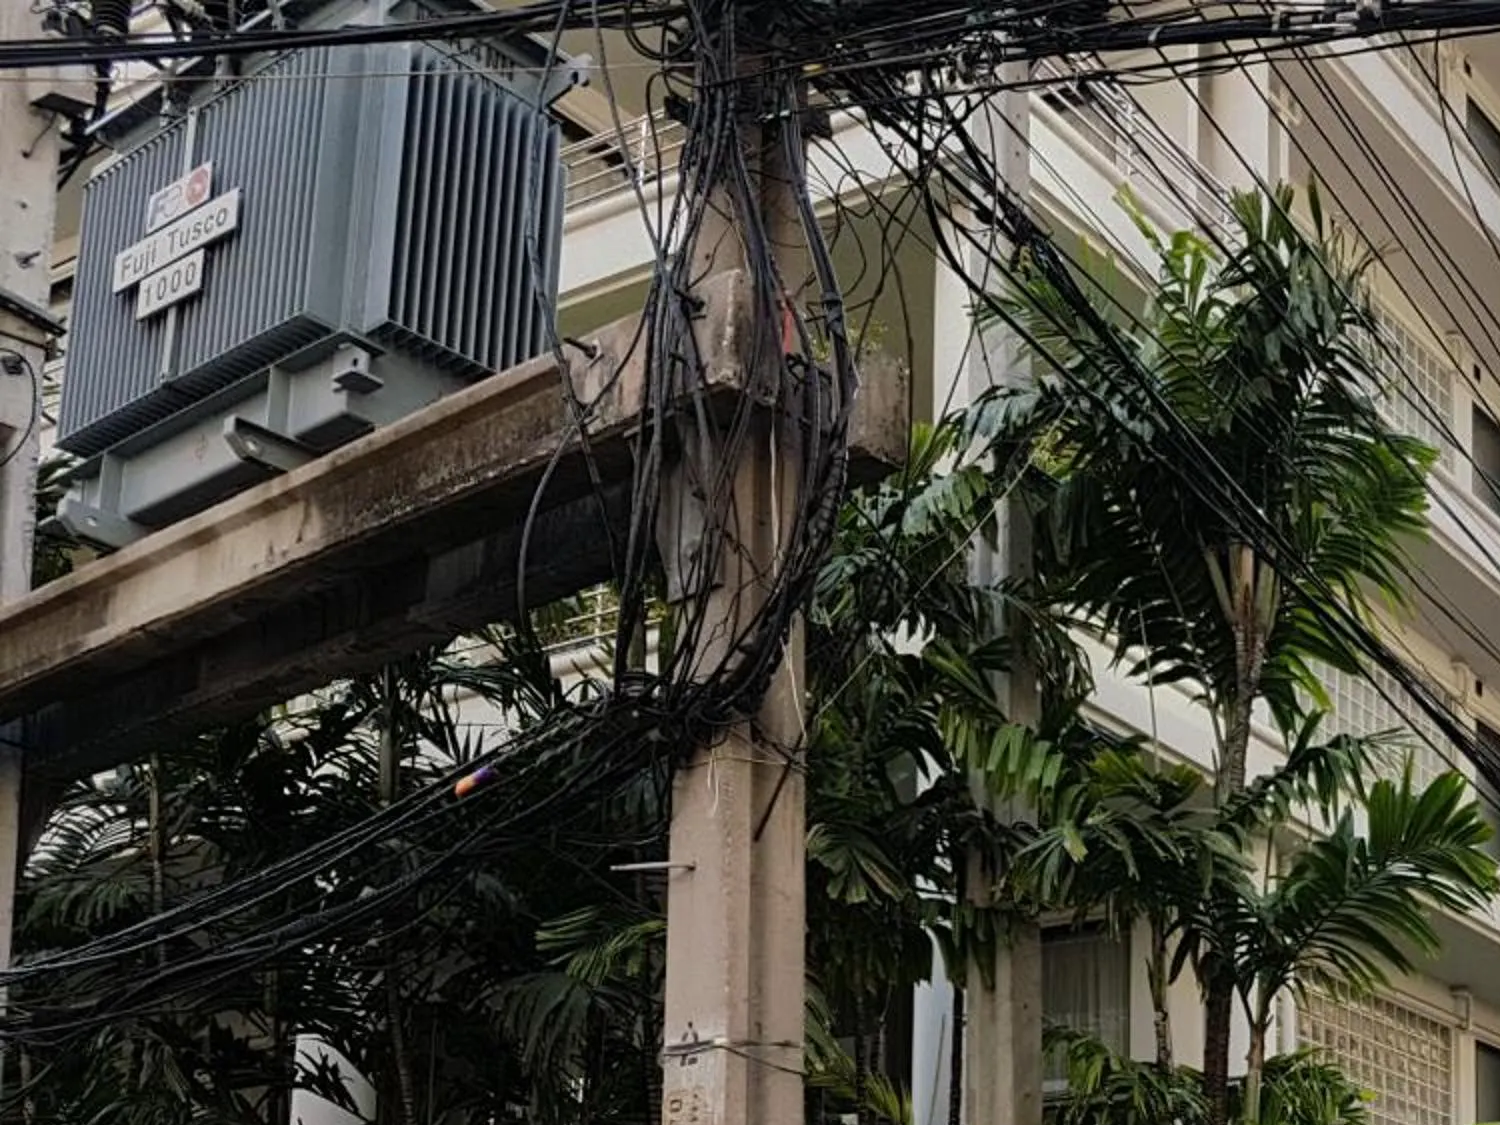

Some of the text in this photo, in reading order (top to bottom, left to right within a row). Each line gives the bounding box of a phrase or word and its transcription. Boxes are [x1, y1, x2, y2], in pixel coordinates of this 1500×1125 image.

[121, 207, 228, 283] Fuji Tusco
[144, 261, 197, 307] 1000
